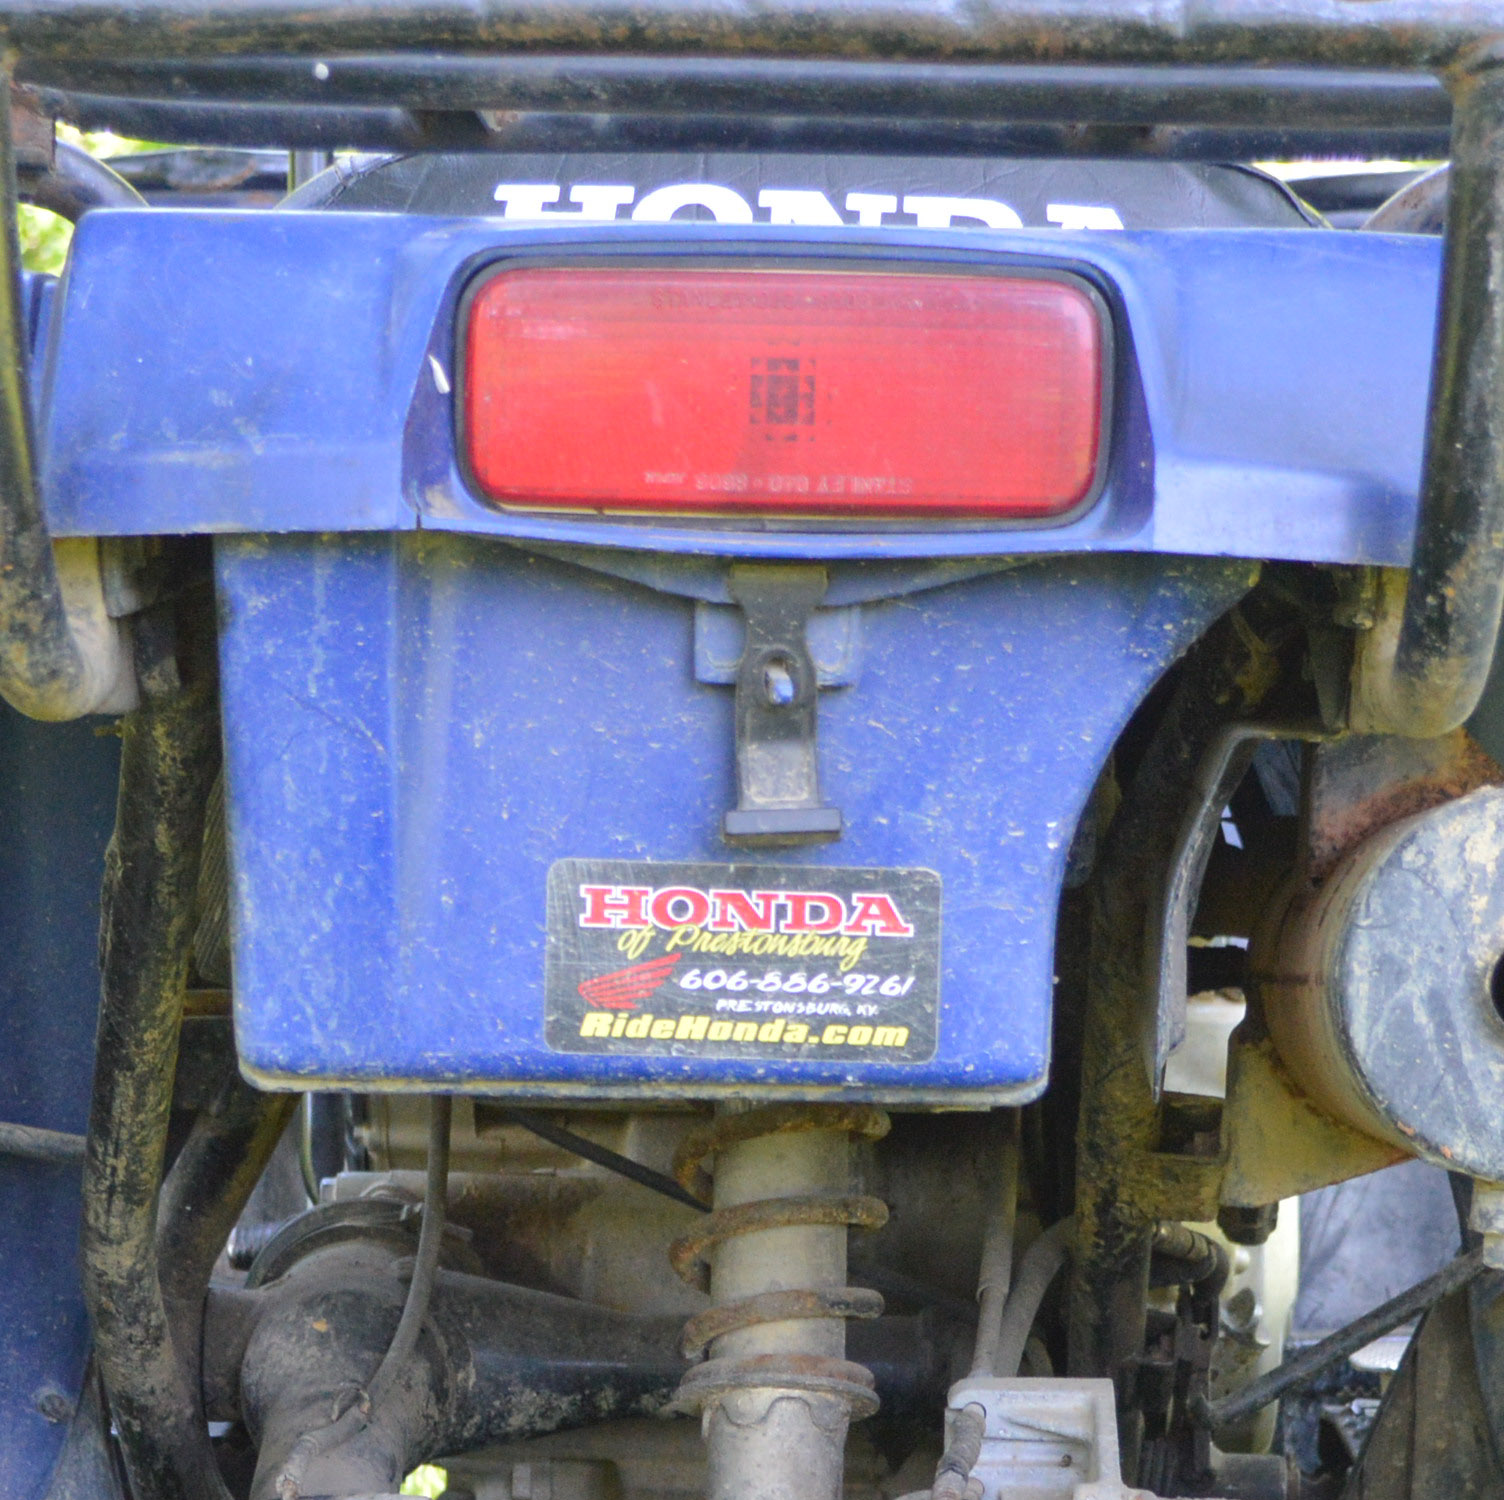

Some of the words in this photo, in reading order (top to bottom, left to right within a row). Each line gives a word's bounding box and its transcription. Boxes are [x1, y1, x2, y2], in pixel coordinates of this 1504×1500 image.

[579, 884, 915, 938] HONDA
[617, 925, 657, 960] of
[665, 923, 869, 971] Prestonsburg
[679, 968, 916, 997] 606-886-9261
[579, 1011, 910, 1047] RideHonda.com
